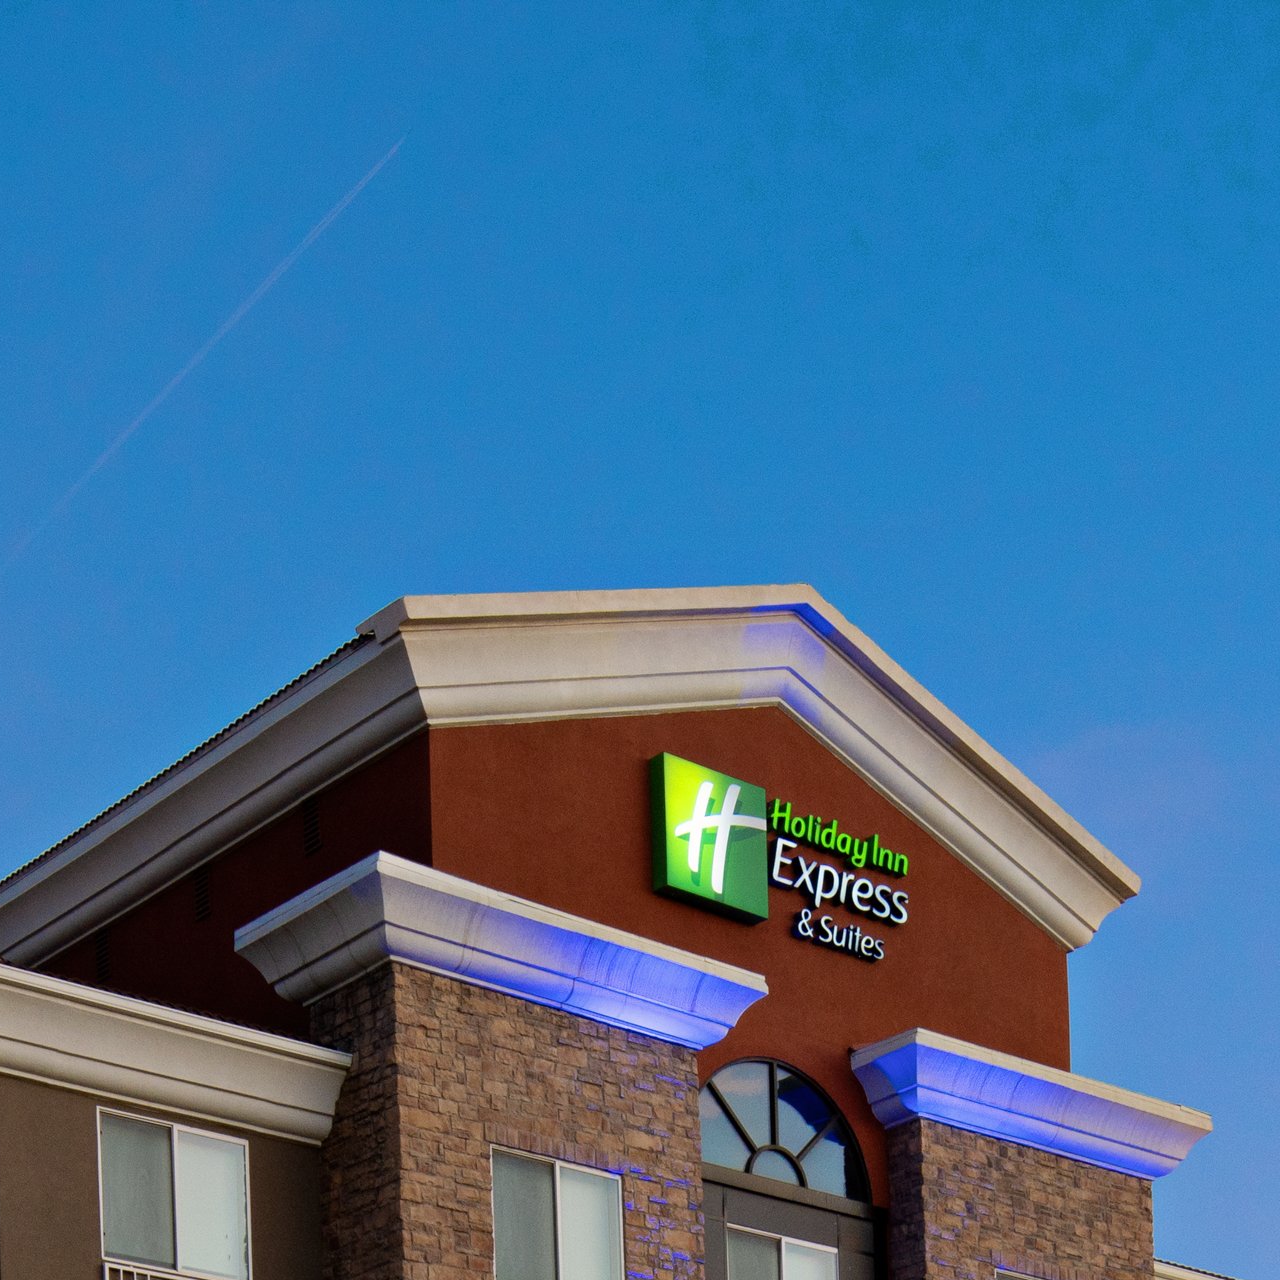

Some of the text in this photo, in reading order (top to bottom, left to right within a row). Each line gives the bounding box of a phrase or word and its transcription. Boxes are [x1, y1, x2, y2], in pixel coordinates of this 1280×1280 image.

[674, 781, 768, 895] H
[770, 798, 909, 876] Holiday Inn
[772, 837, 909, 924] Express
[797, 908, 885, 960] & Suites
